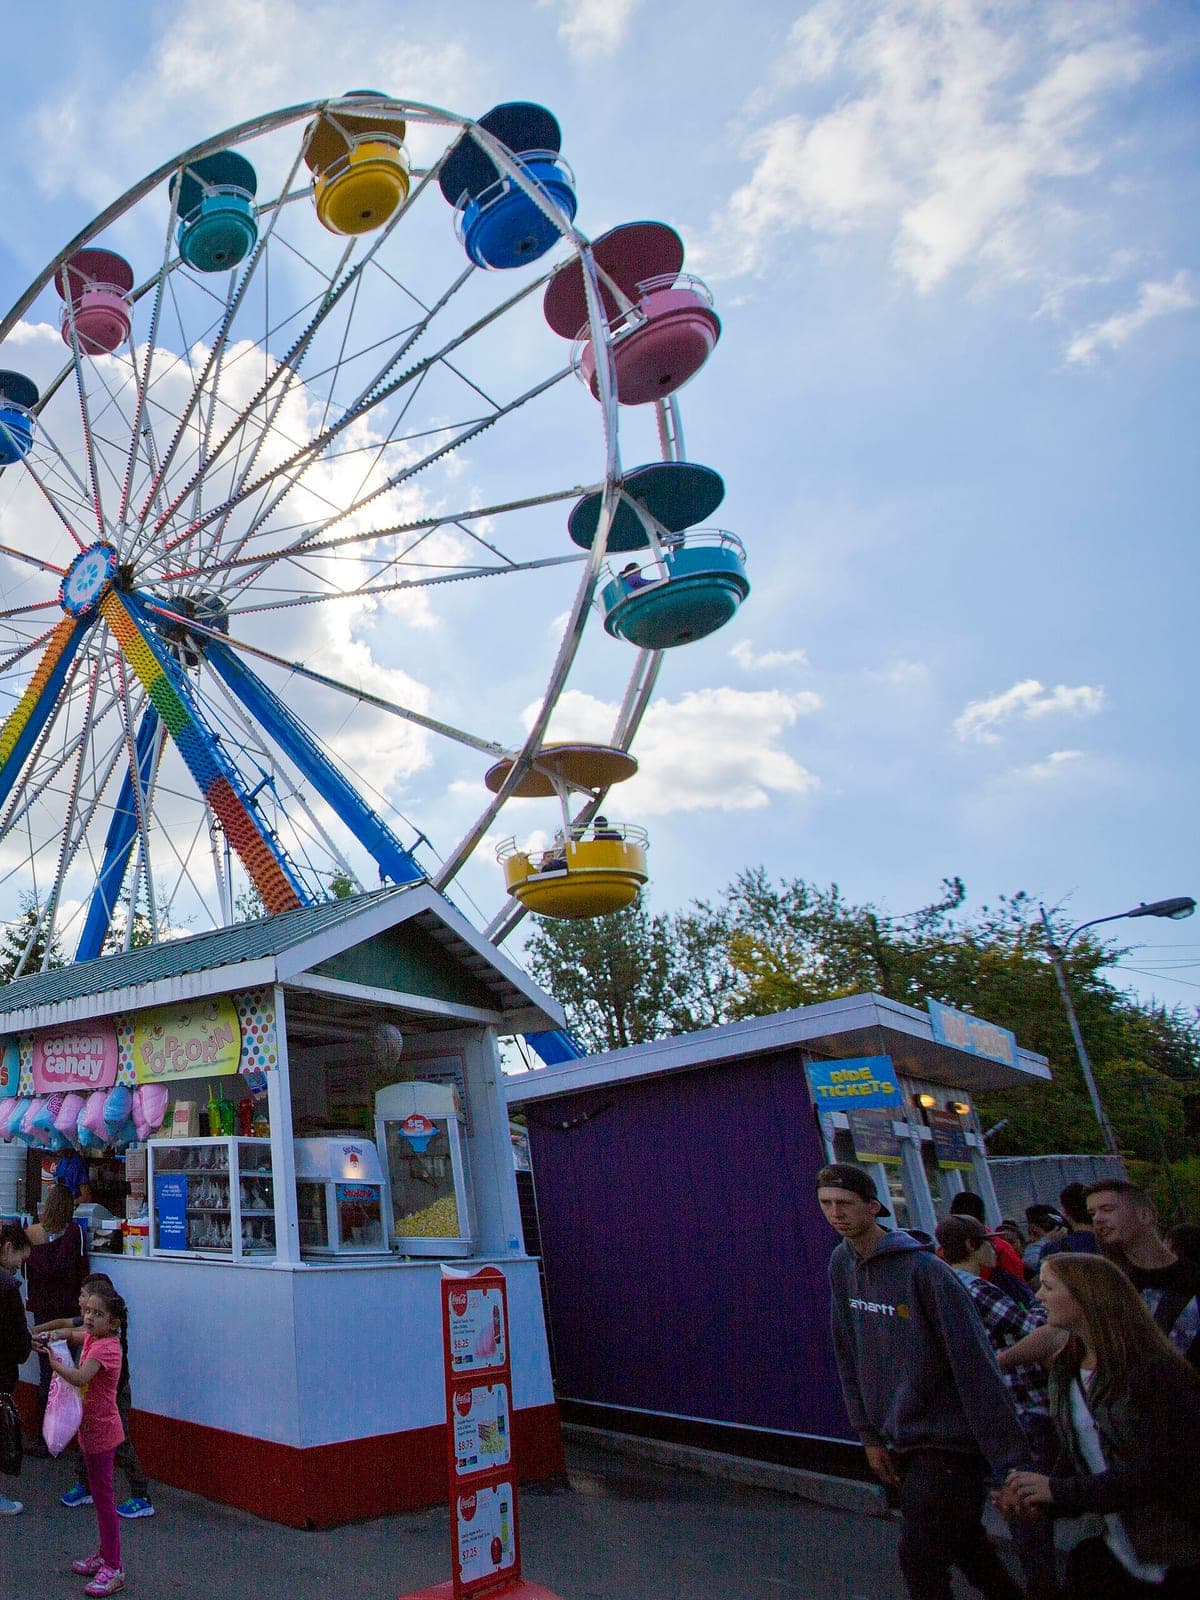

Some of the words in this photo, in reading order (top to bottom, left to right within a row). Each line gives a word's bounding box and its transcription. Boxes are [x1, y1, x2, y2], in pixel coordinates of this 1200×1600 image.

[43, 1034, 104, 1056] cotton
[140, 1023, 234, 1073] POPCORN
[45, 1054, 104, 1081] candy
[830, 1067, 873, 1083] RIDE
[817, 1080, 894, 1097] TICKETS
[408, 1119, 424, 1130] $5
